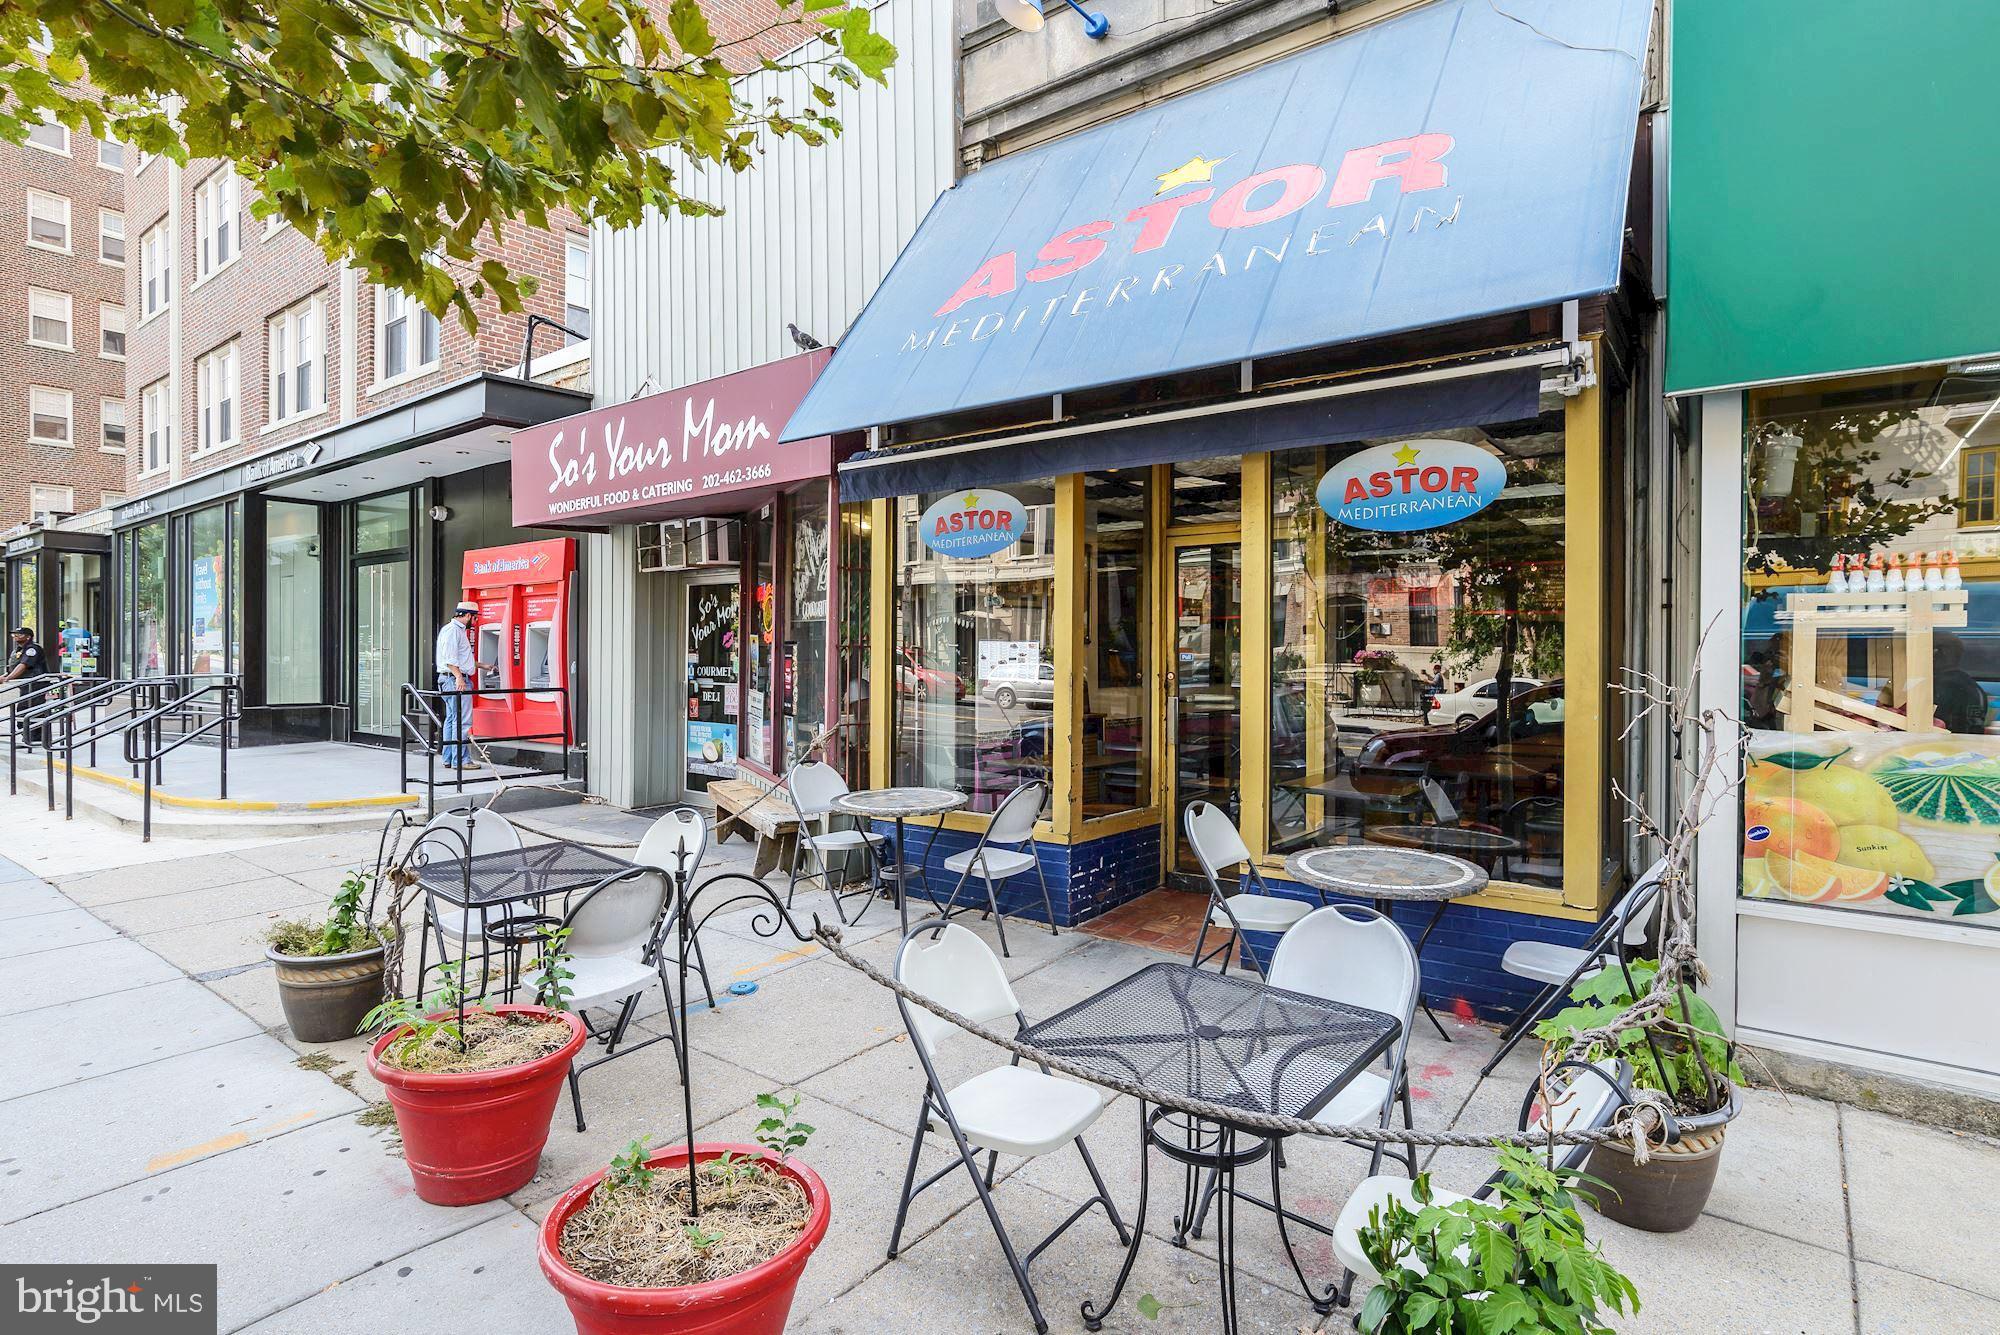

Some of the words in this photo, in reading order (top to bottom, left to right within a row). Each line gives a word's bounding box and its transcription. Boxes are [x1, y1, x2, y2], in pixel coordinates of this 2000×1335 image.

[933, 132, 1456, 317] ASTOR
[897, 194, 1464, 356] MEDITERRANEAN
[548, 426, 597, 494] So's
[605, 416, 673, 481] Your
[682, 397, 771, 463] Mom
[245, 460, 263, 482] Bank
[269, 450, 299, 475] America
[548, 494, 603, 515] WONDERFUL
[603, 490, 631, 507] FOOD
[631, 488, 640, 500] &
[641, 478, 693, 499] CATERING
[702, 463, 772, 489] 202-462-3666
[1343, 466, 1479, 506] ASTOR
[1337, 494, 1483, 521] MEDITERRANEAN
[934, 508, 1013, 537] ASTOR
[931, 530, 1016, 550] MEDITERRANEAN
[473, 560, 491, 575] Bank
[499, 556, 530, 572] America
[698, 593, 719, 622] So's
[691, 622, 717, 649] Your
[697, 666, 733, 677] GOURMET
[702, 691, 721, 702] DELI
[1856, 843, 1889, 853] Sunkist
